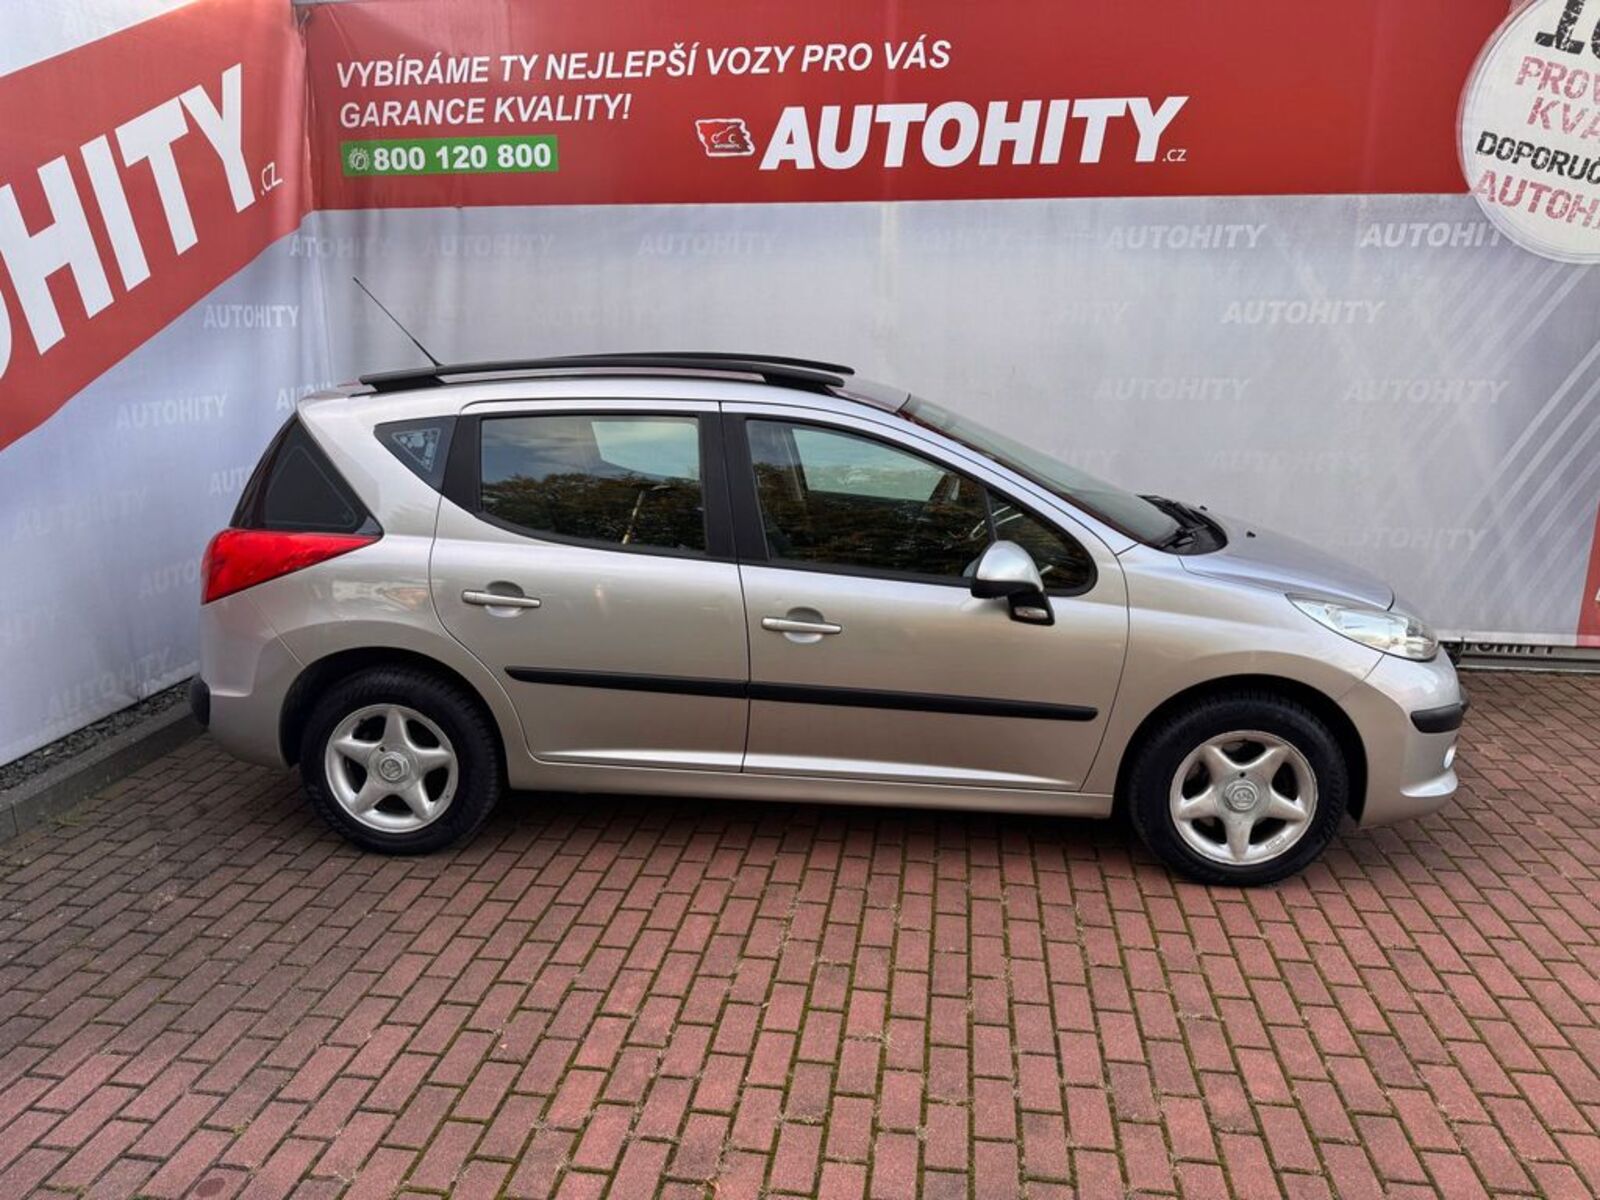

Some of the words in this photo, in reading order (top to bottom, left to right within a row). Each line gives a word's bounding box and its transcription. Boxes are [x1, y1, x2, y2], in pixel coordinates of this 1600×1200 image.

[336, 52, 490, 88] VYBÍRÁME
[500, 54, 539, 82] TY
[545, 42, 699, 80] NEJLEPŠÍ
[706, 45, 795, 75] VOZY
[801, 42, 873, 73] PRO
[884, 34, 951, 70] VÁS
[340, 97, 485, 128] GARANCE
[493, 93, 632, 123] KVALITY!
[373, 147, 426, 171] 800
[436, 145, 487, 169] 120
[497, 143, 552, 168] 800
[636, 232, 780, 256] AUTOHITY
[1104, 224, 1268, 249] AUTOHITY
[203, 304, 300, 329] AUTOHITY
[1220, 300, 1385, 325] AUTOHITY
[1094, 377, 1251, 401] AUTOHITY
[1343, 378, 1510, 403] AUTOHITY
[112, 394, 230, 432] AUTOHITY
